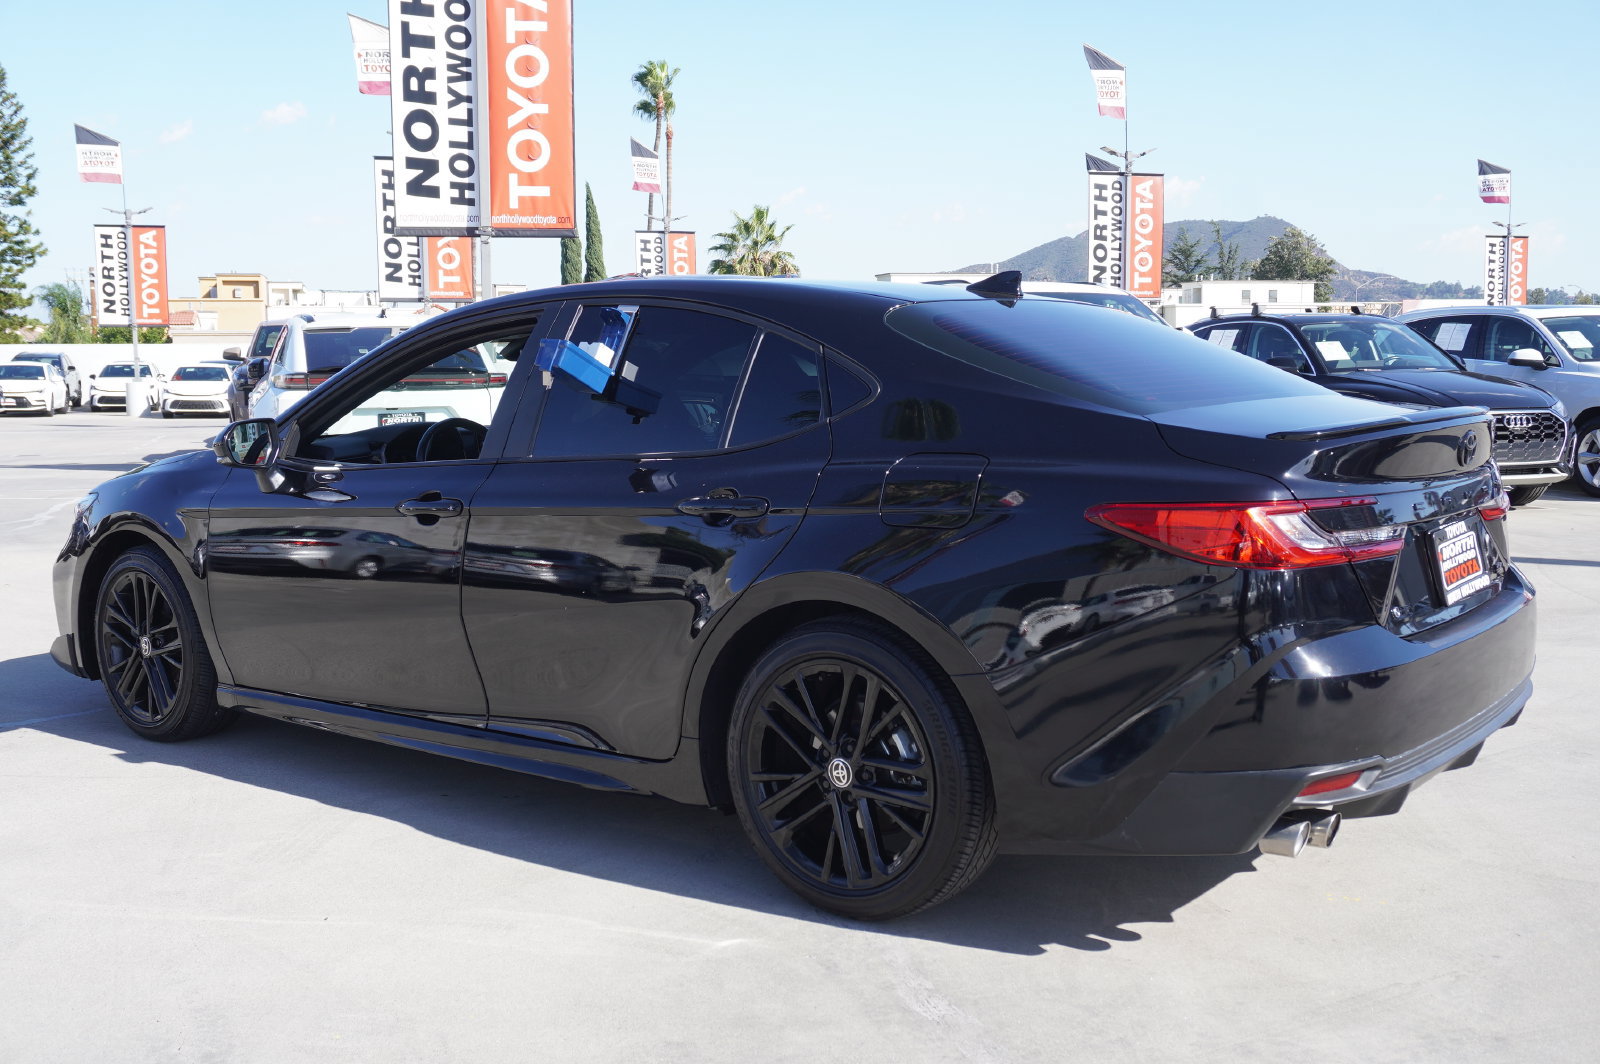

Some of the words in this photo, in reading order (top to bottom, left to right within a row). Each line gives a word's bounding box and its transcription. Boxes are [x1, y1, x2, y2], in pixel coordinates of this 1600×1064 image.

[381, 168, 403, 283] NORTH
[491, 214, 571, 226] northhollywoodtoyota.com
[1093, 182, 1108, 284] NORTH
[1110, 180, 1123, 288] HOLLYWOOD
[1134, 179, 1154, 289] TOYOTA
[100, 233, 117, 314] NORTH
[117, 230, 131, 317] HOLLYWOOD
[139, 229, 160, 318] TOYOTA
[673, 235, 689, 275] OTA
[1487, 242, 1497, 306] NORTH
[1510, 239, 1524, 306] TOYOTA
[1442, 536, 1475, 561] NORTH
[1442, 549, 1477, 572] HOLLYWOOD
[1444, 521, 1467, 540] TOYOTA
[1444, 559, 1480, 585] TOYOTA
